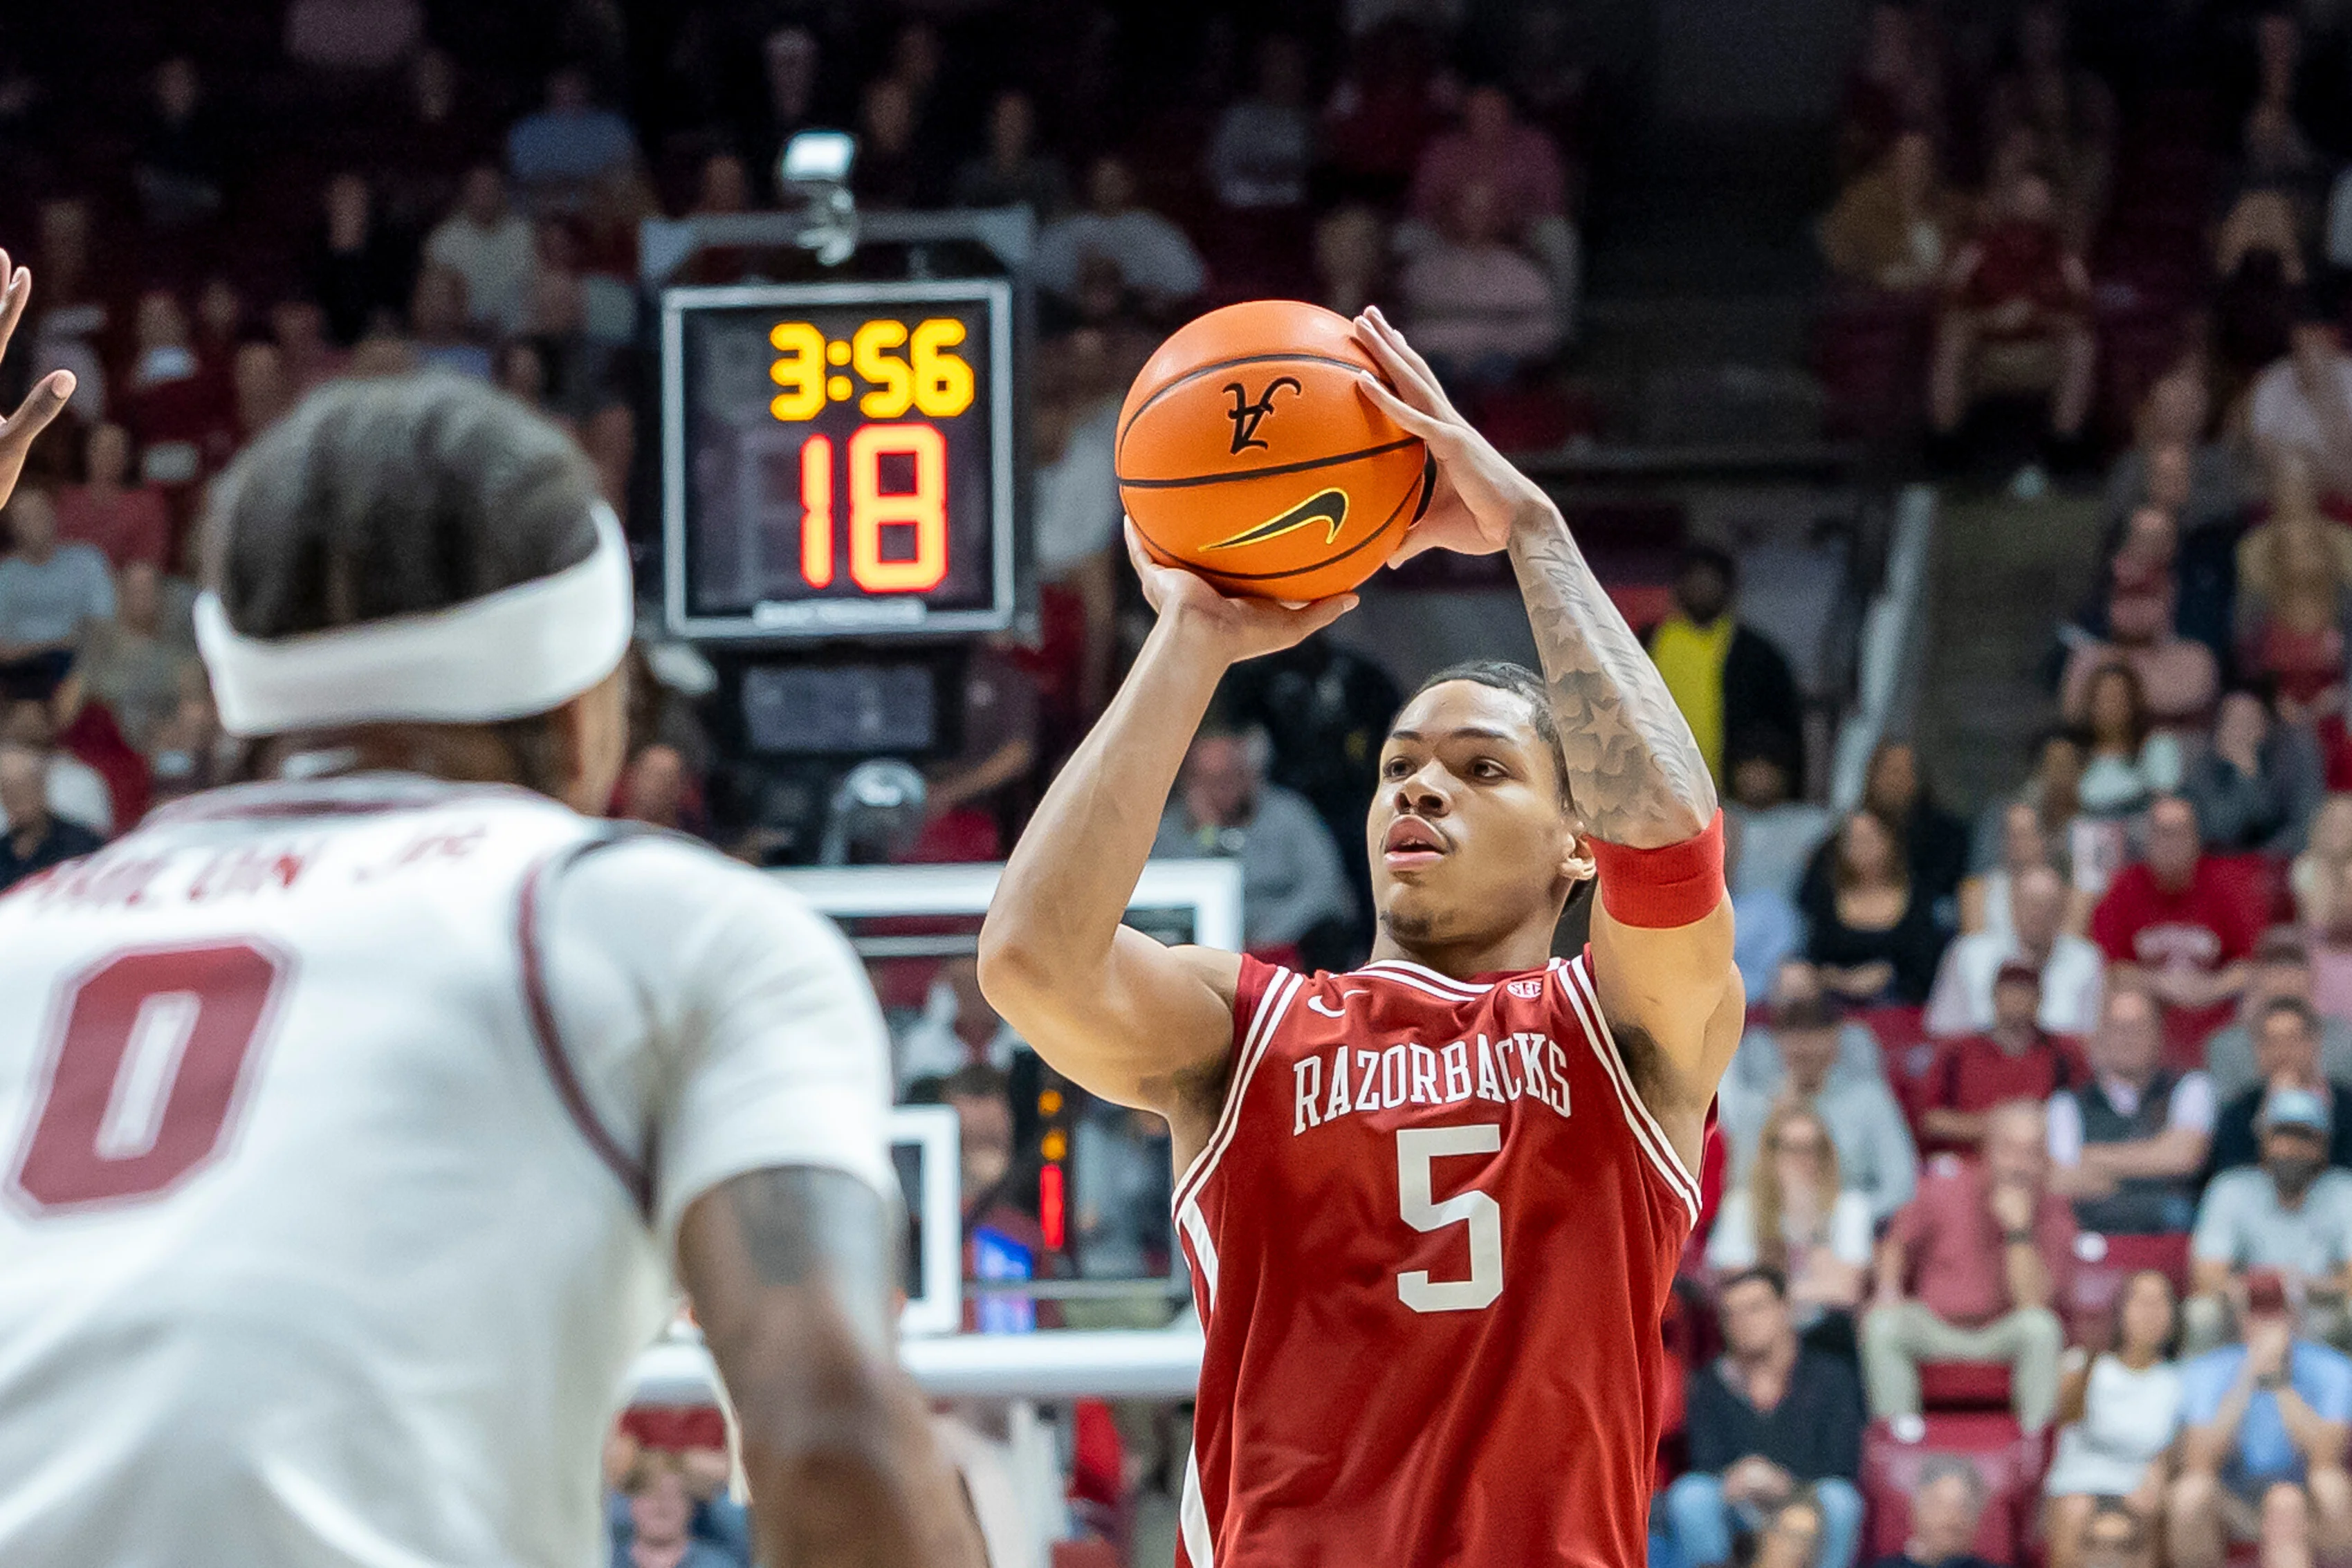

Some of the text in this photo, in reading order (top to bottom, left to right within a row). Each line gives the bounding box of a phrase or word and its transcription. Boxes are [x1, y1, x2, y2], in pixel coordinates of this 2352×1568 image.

[770, 317, 974, 421] 3:56
[800, 423, 948, 593] 18
[6, 937, 296, 1220] 0
[1293, 1033, 1571, 1136] RAZORBACKS
[1396, 1123, 1504, 1313] 5
